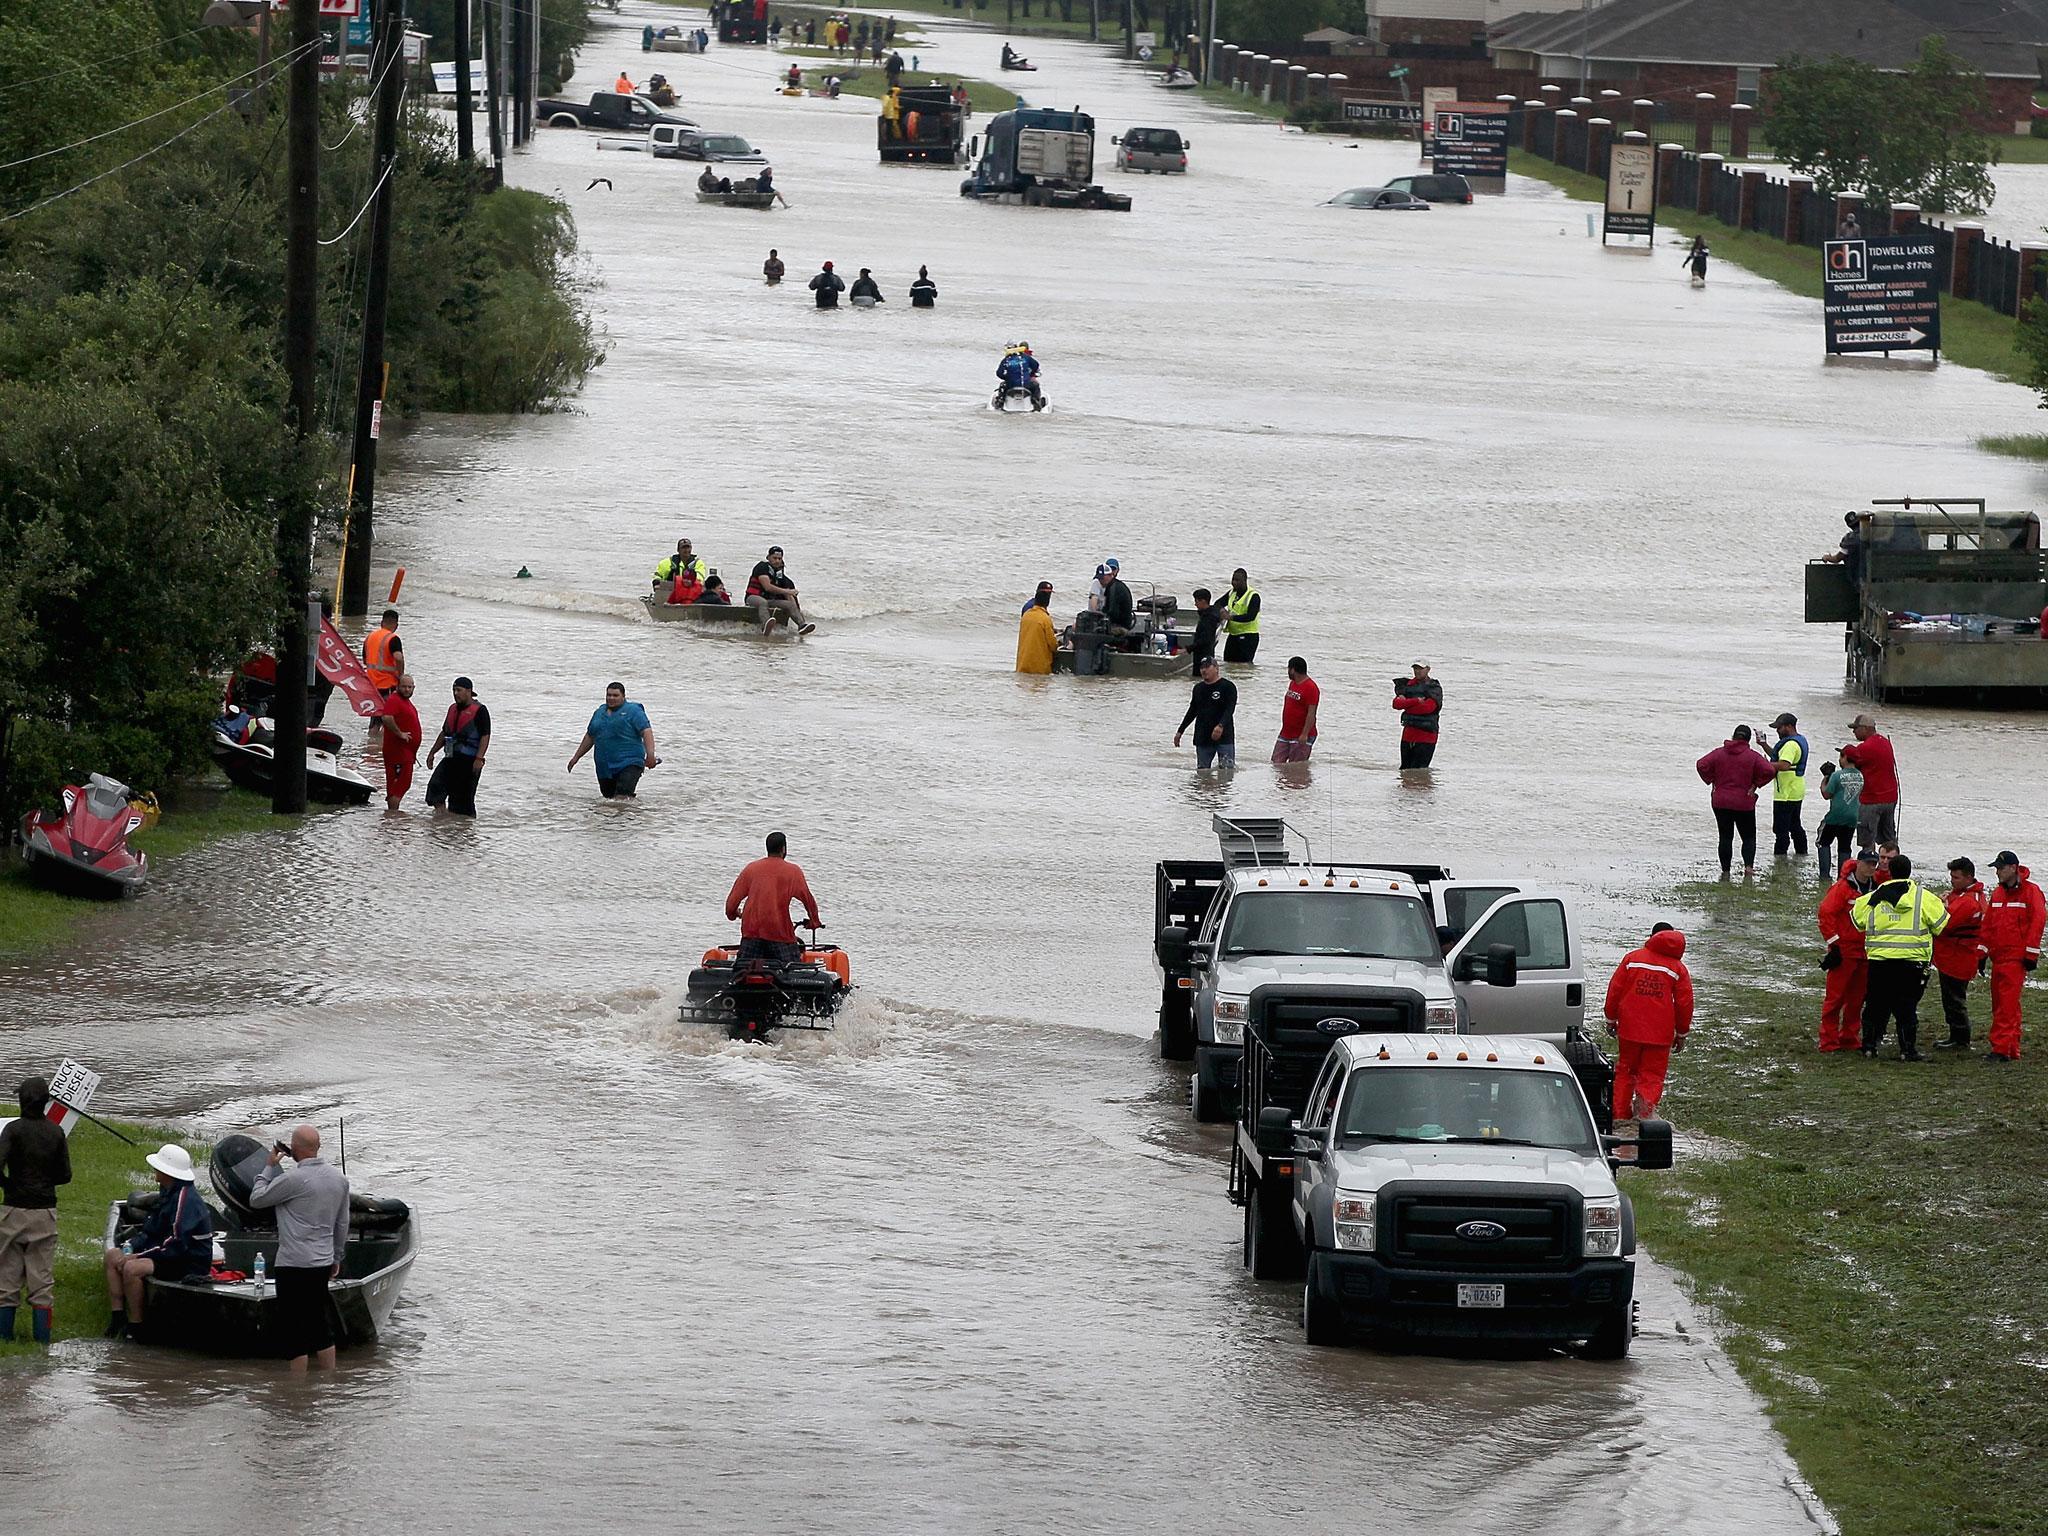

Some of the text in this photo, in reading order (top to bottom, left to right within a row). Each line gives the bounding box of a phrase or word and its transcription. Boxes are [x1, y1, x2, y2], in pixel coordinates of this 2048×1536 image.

[1347, 105, 1393, 118] TIDWELL
[1440, 115, 1460, 131] dh
[1620, 179, 1642, 187] Lakes
[1868, 245, 1936, 256] TIDWELL LAKES
[1830, 244, 1861, 270] dh
[1872, 263, 1892, 271] From
[1906, 261, 1933, 270] $170s
[1830, 270, 1862, 279] Homes
[1834, 284, 1855, 292] DOWN
[1855, 283, 1886, 291] PAYMENT
[1825, 305, 1841, 313] WHY
[1842, 304, 1864, 312] LEASE
[1865, 303, 1886, 312] WHEN
[1886, 302, 1901, 311] YOU
[1901, 302, 1917, 310] CAN
[1848, 318, 1873, 326] CREDIT
[1873, 317, 1894, 325] TIERS
[1838, 331, 1909, 342] 844-91-HOUSE
[1636, 980, 1666, 990] COAST
[1635, 987, 1664, 998] GUARD
[50, 1060, 76, 1094] TRUCK
[61, 1069, 88, 1103] DIESEL
[1473, 1289, 1501, 1302] 0245P
